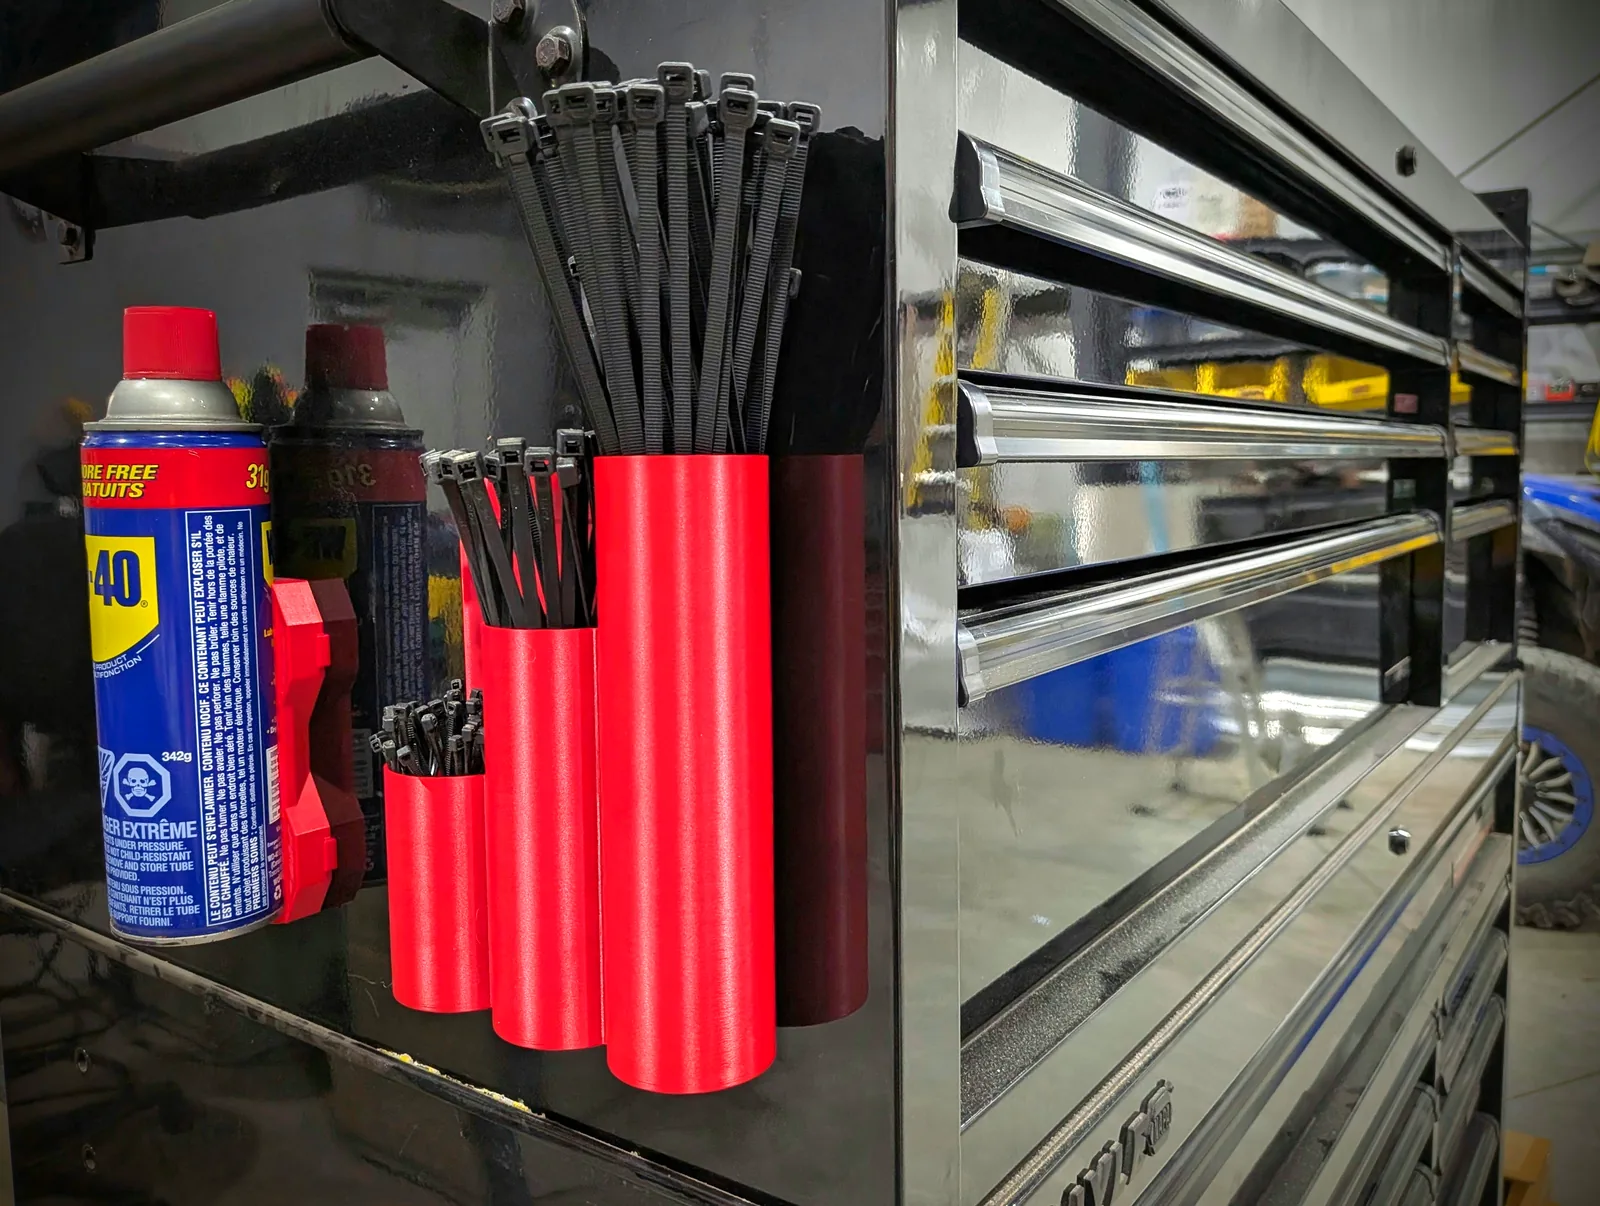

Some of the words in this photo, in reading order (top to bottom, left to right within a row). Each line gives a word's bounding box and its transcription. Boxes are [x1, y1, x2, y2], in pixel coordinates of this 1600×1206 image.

[105, 463, 159, 480] FREE
[245, 463, 270, 493] 31g
[203, 515, 213, 530] des
[215, 523, 223, 534] de
[191, 530, 202, 548] S'IL
[204, 532, 215, 557] portée
[216, 535, 224, 544] et
[226, 532, 235, 565] chaleur.
[205, 559, 214, 567] la
[216, 546, 227, 570] pilote,
[192, 549, 204, 598] EXPLOSER
[206, 569, 215, 579] de
[228, 566, 236, 577] de
[206, 581, 216, 599] hors
[218, 572, 227, 603] flamme
[195, 598, 205, 624] PEUT
[207, 600, 217, 621] Tenir
[230, 611, 238, 626] des
[208, 623, 218, 649] brûler.
[220, 621, 228, 638] telle
[231, 627, 239, 642] loin
[196, 625, 208, 680] CONTENANT
[212, 650, 221, 665] pas
[221, 639, 232, 677] flammes,
[95, 653, 127, 671] PRODUCT
[232, 643, 241, 683] Conserver
[211, 666, 220, 679] Ne
[199, 681, 209, 694] CE
[223, 678, 231, 693] des
[211, 680, 223, 714] perforer.
[224, 694, 232, 709] loin
[234, 684, 244, 726] électrique.
[200, 695, 211, 727] NOCIF.
[216, 715, 224, 730] pas
[224, 710, 233, 731] Tenir
[214, 731, 223, 743] Ne
[225, 732, 234, 753] aéré.
[236, 726, 244, 755] moteur
[161, 750, 192, 763] 342g
[201, 728, 213, 771] CONTENU
[214, 744, 224, 772] avaler.
[226, 753, 235, 771] bien
[240, 755, 245, 766] un
[218, 771, 226, 787] pas
[227, 771, 236, 800] endroit
[217, 787, 226, 800] Ne
[238, 779, 248, 819] étincelles,
[204, 772, 216, 841] S'ENFLAMMER.
[217, 801, 227, 828] fumer.
[231, 800, 237, 811] un
[122, 818, 198, 840] EXTRÊME
[229, 812, 238, 832] dans
[240, 819, 248, 835] des
[221, 827, 229, 843] pas
[115, 838, 136, 850] UNDER
[137, 841, 187, 851] PRESSURE.
[207, 840, 217, 866] PEUT
[219, 843, 228, 856] Ne
[250, 835, 258, 864] SOINS
[120, 850, 192, 862] CHILD-RESISTANT
[241, 834, 251, 876] produisant
[110, 865, 140, 881] PROVIDED.
[124, 860, 139, 871] AND
[140, 862, 168, 872] STORE
[169, 861, 195, 872] TUBE
[231, 848, 240, 884] N'utiliser
[208, 866, 220, 909] CONTENU
[218, 857, 231, 901] CHAUFFÉ.
[243, 875, 252, 897] objet
[252, 864, 260, 910] PREMIERS
[121, 882, 140, 895] SOUS
[140, 885, 187, 896] PRESSION.
[143, 896, 167, 906] N'EST
[168, 895, 194, 906] PLUS
[233, 884, 242, 916] enfants.
[129, 905, 162, 916] RETIRER
[163, 906, 175, 916] LE
[176, 904, 201, 916] TUBE
[210, 908, 220, 922] LE
[222, 900, 231, 919] EST
[139, 916, 174, 927] FOURNI.
